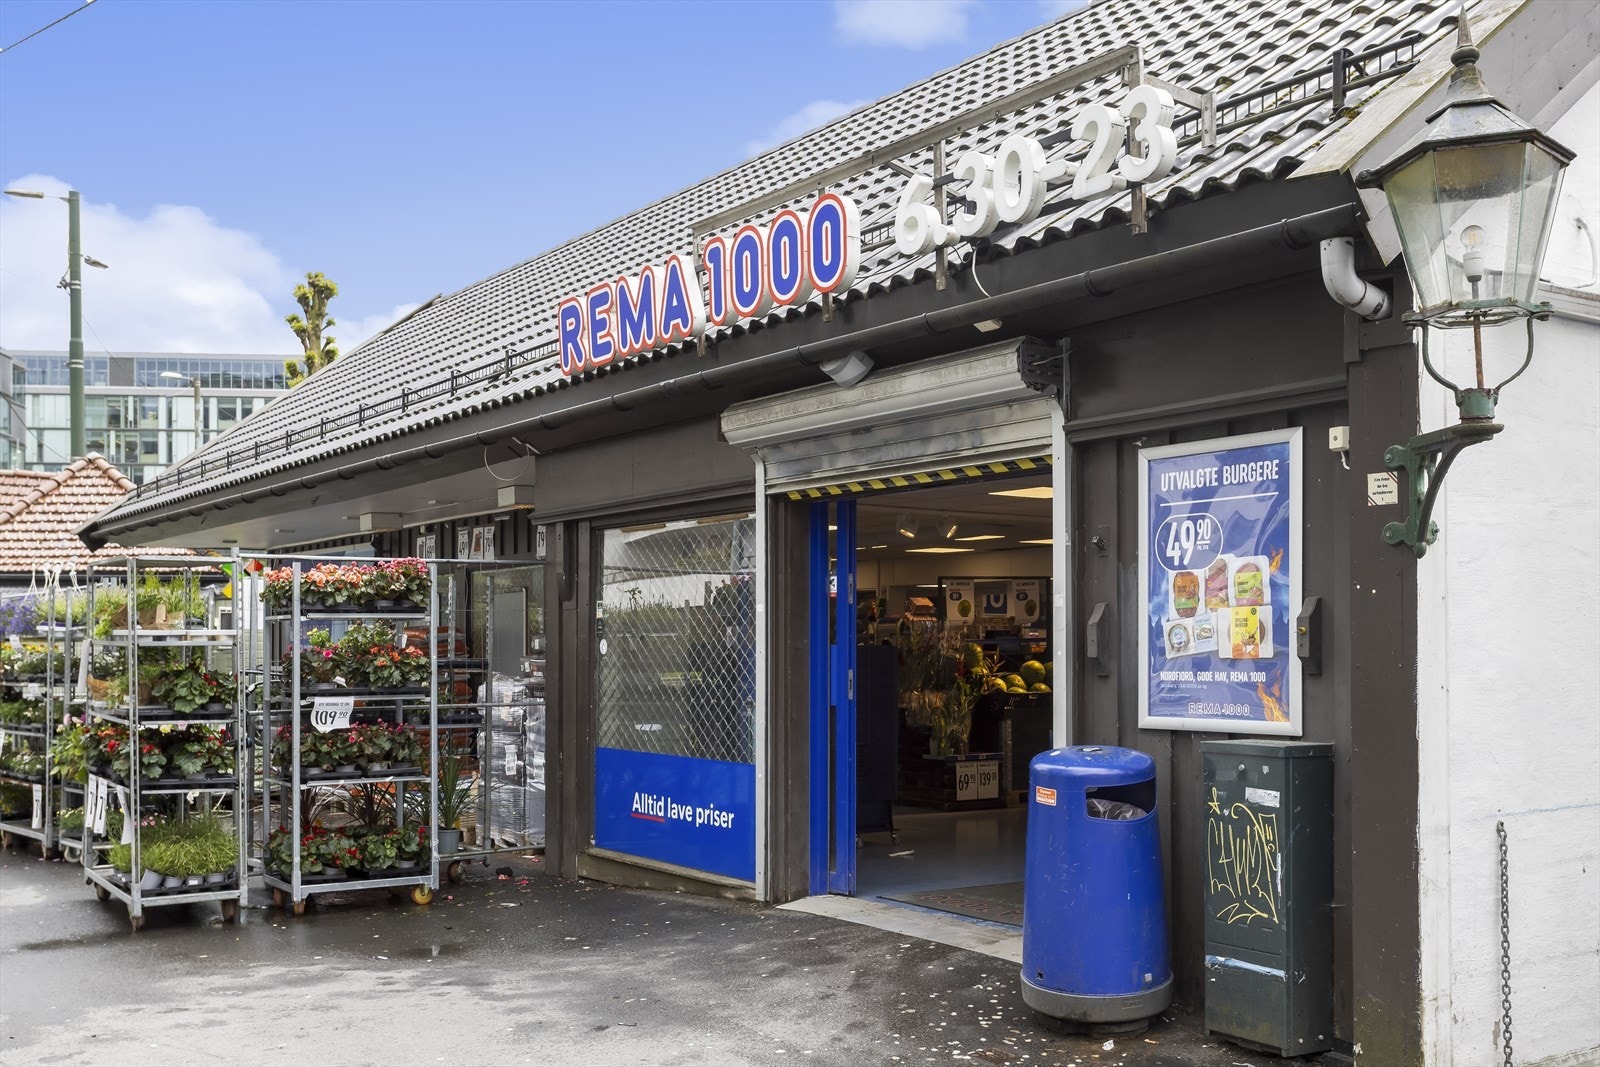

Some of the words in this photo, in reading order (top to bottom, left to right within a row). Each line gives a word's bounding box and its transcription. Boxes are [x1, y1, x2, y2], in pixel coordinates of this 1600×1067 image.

[558, 254, 700, 376] REMA
[703, 194, 853, 327] 1000
[1160, 466, 1219, 492] UTVALGTE
[1222, 459, 1280, 486] BURGERE
[1166, 520, 1195, 566] 49
[1196, 518, 1211, 540] 90
[1160, 671, 1195, 682] NORDFJORD,
[1196, 671, 1213, 681] GODE
[1214, 671, 1228, 683] HAV,
[1230, 671, 1248, 682] REMA
[1249, 671, 1266, 682] 1000
[315, 710, 337, 725] 109
[1188, 702, 1221, 715] REMA
[1222, 703, 1250, 716] 1000
[958, 773, 969, 791] 69
[979, 772, 991, 786] 139
[632, 791, 665, 817] Alltid
[667, 797, 693, 822] lave
[696, 803, 735, 828] priser
